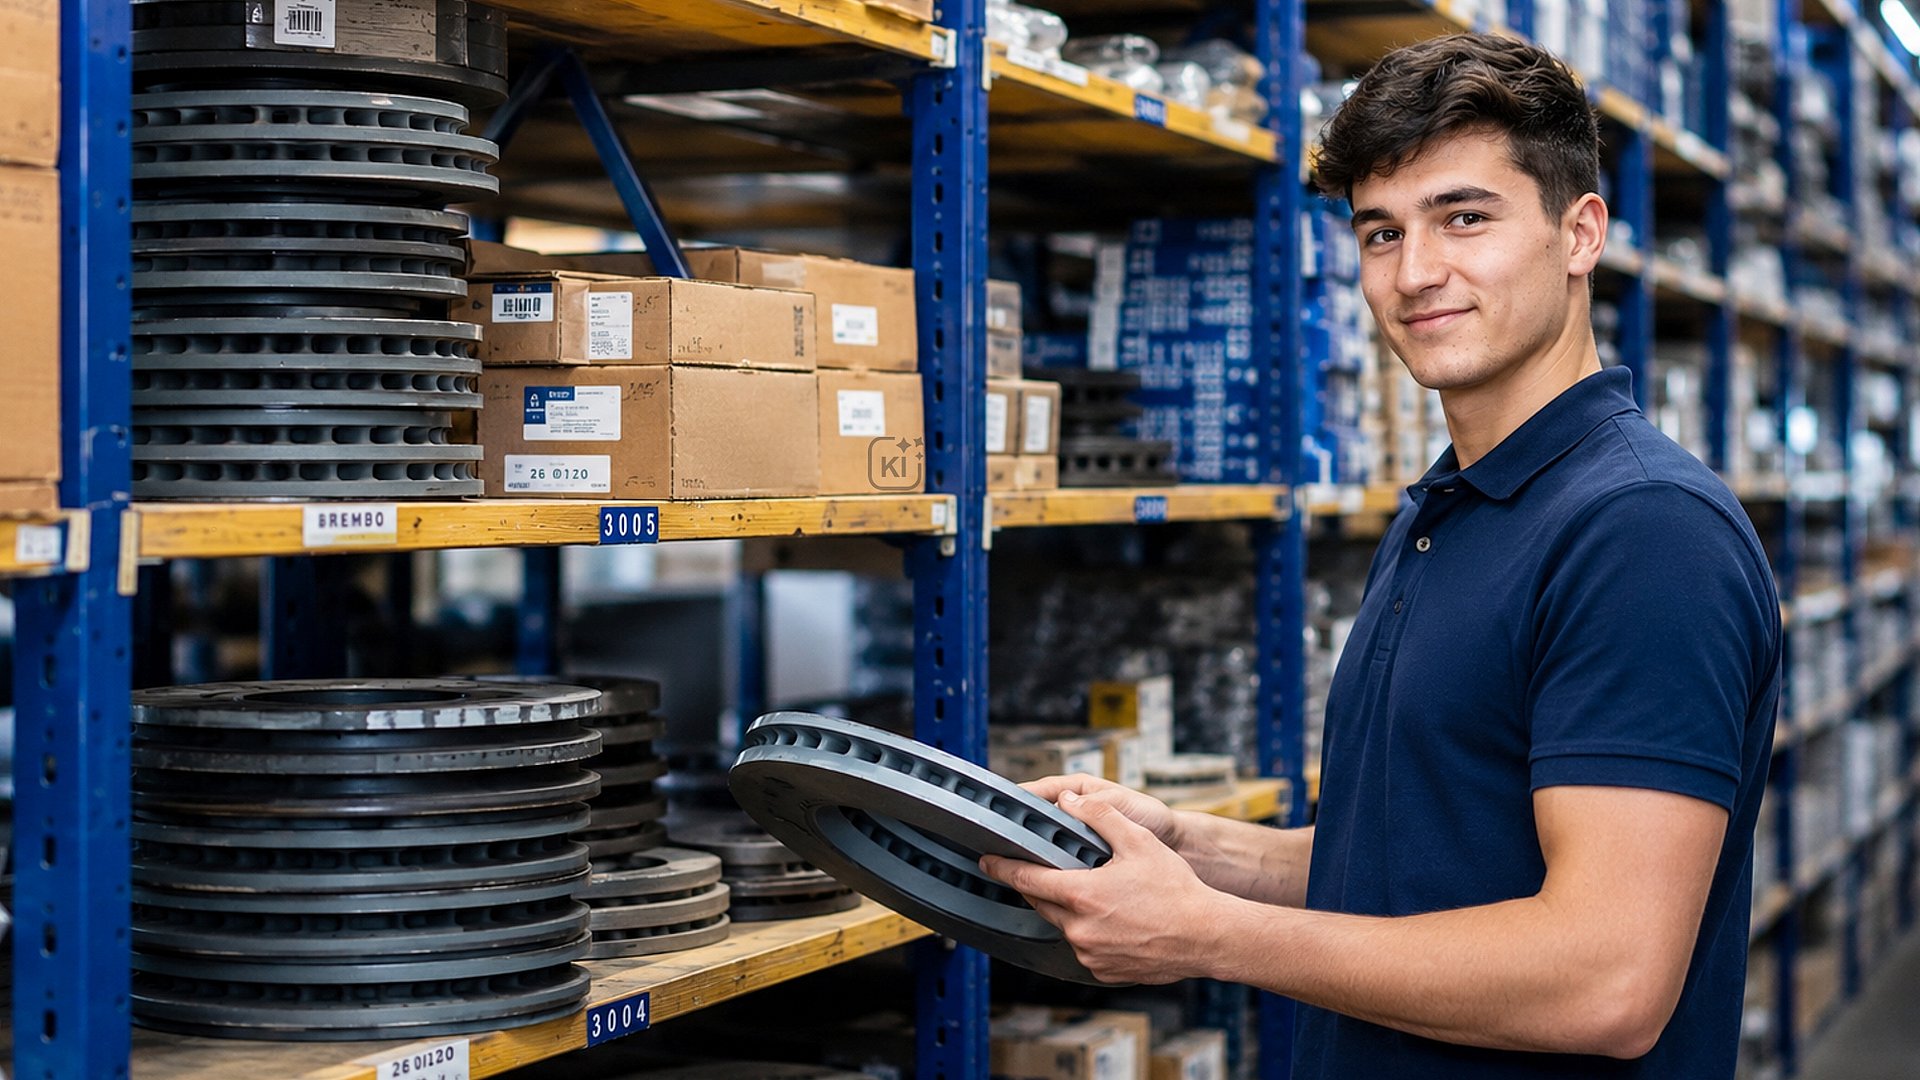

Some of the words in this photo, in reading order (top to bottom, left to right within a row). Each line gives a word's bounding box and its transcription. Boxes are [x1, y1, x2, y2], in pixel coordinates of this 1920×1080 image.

[529, 468, 546, 480] 26
[318, 511, 384, 529] BREMBO
[604, 512, 655, 537] 3005
[592, 999, 646, 1038] 3004
[392, 1059, 410, 1078] 26
